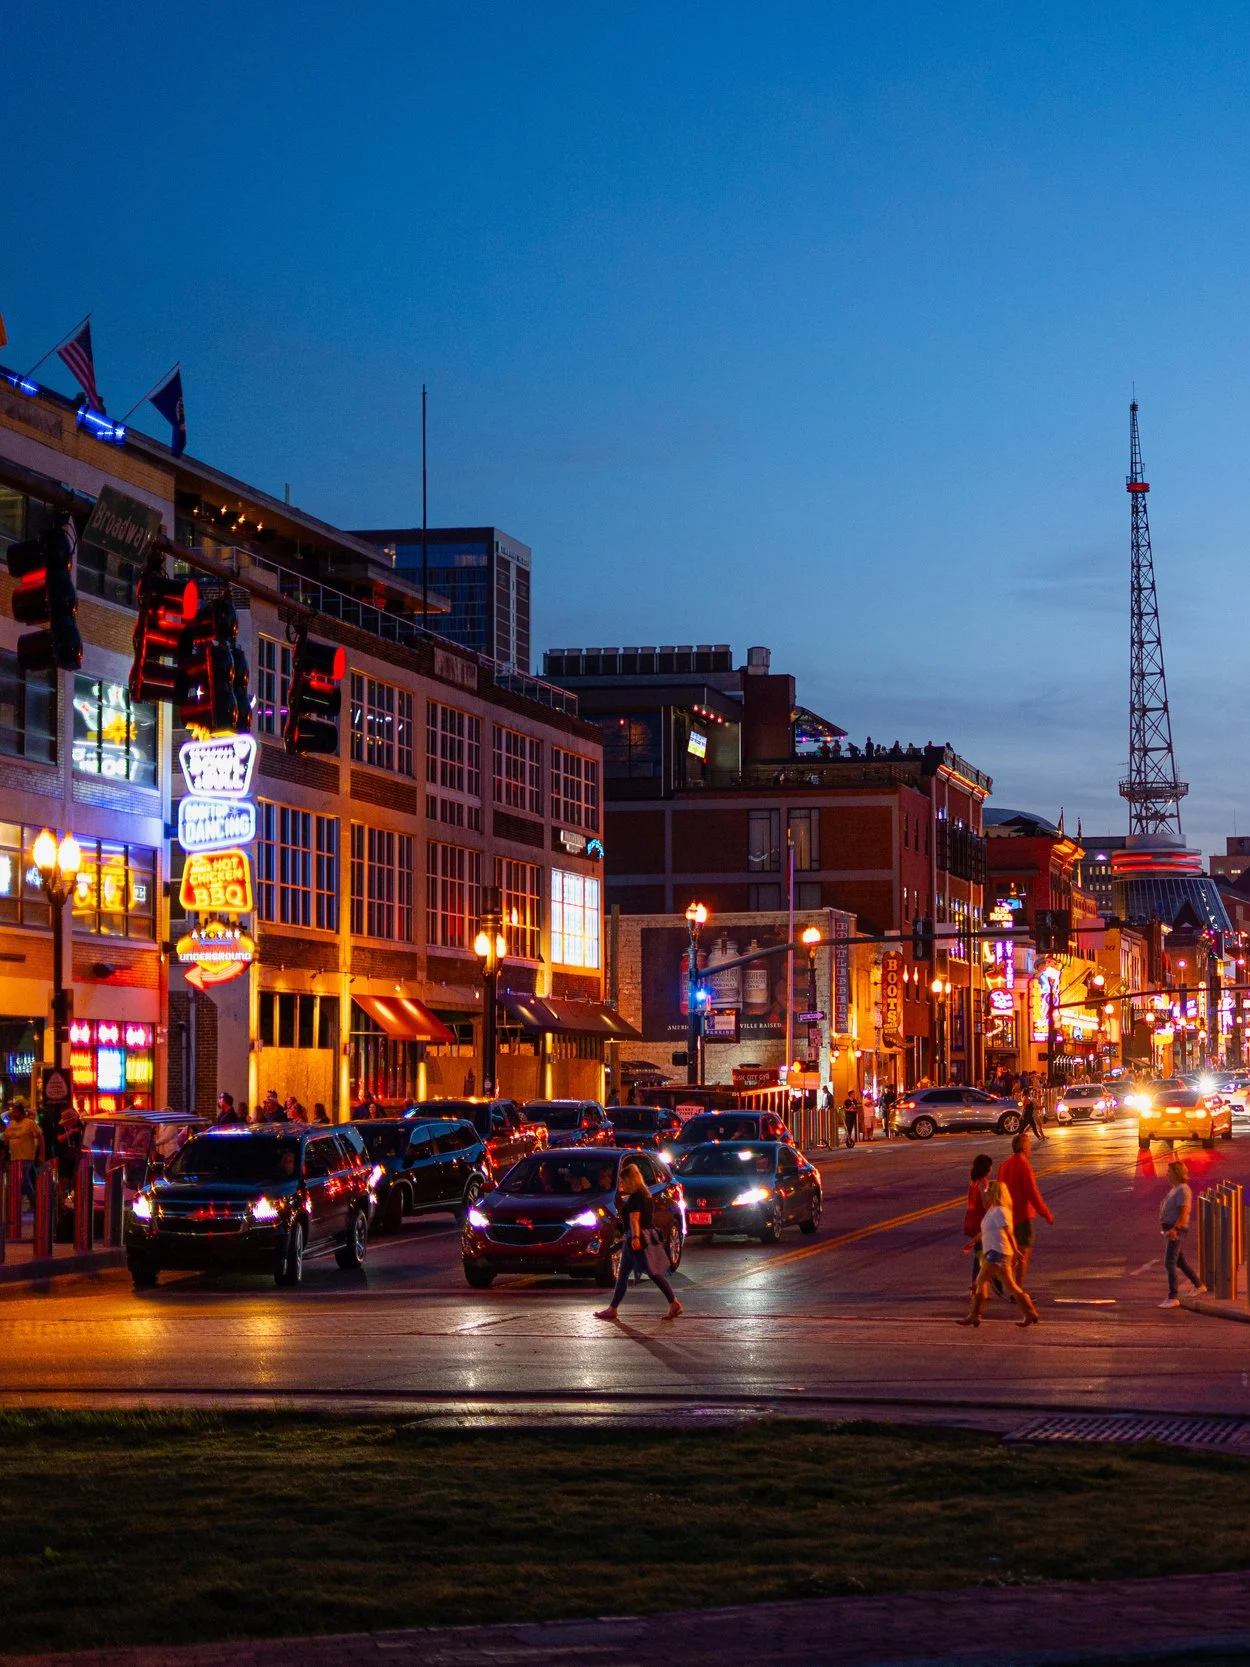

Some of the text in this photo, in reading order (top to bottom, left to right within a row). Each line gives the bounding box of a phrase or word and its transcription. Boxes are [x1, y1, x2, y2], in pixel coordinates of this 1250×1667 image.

[91, 501, 152, 556] Broadway
[185, 815, 250, 843] DANCING
[190, 868, 243, 885] CHICKEN
[212, 858, 239, 871] HOT
[193, 886, 244, 906] BBQ
[886, 959, 898, 1022] BOOTS
